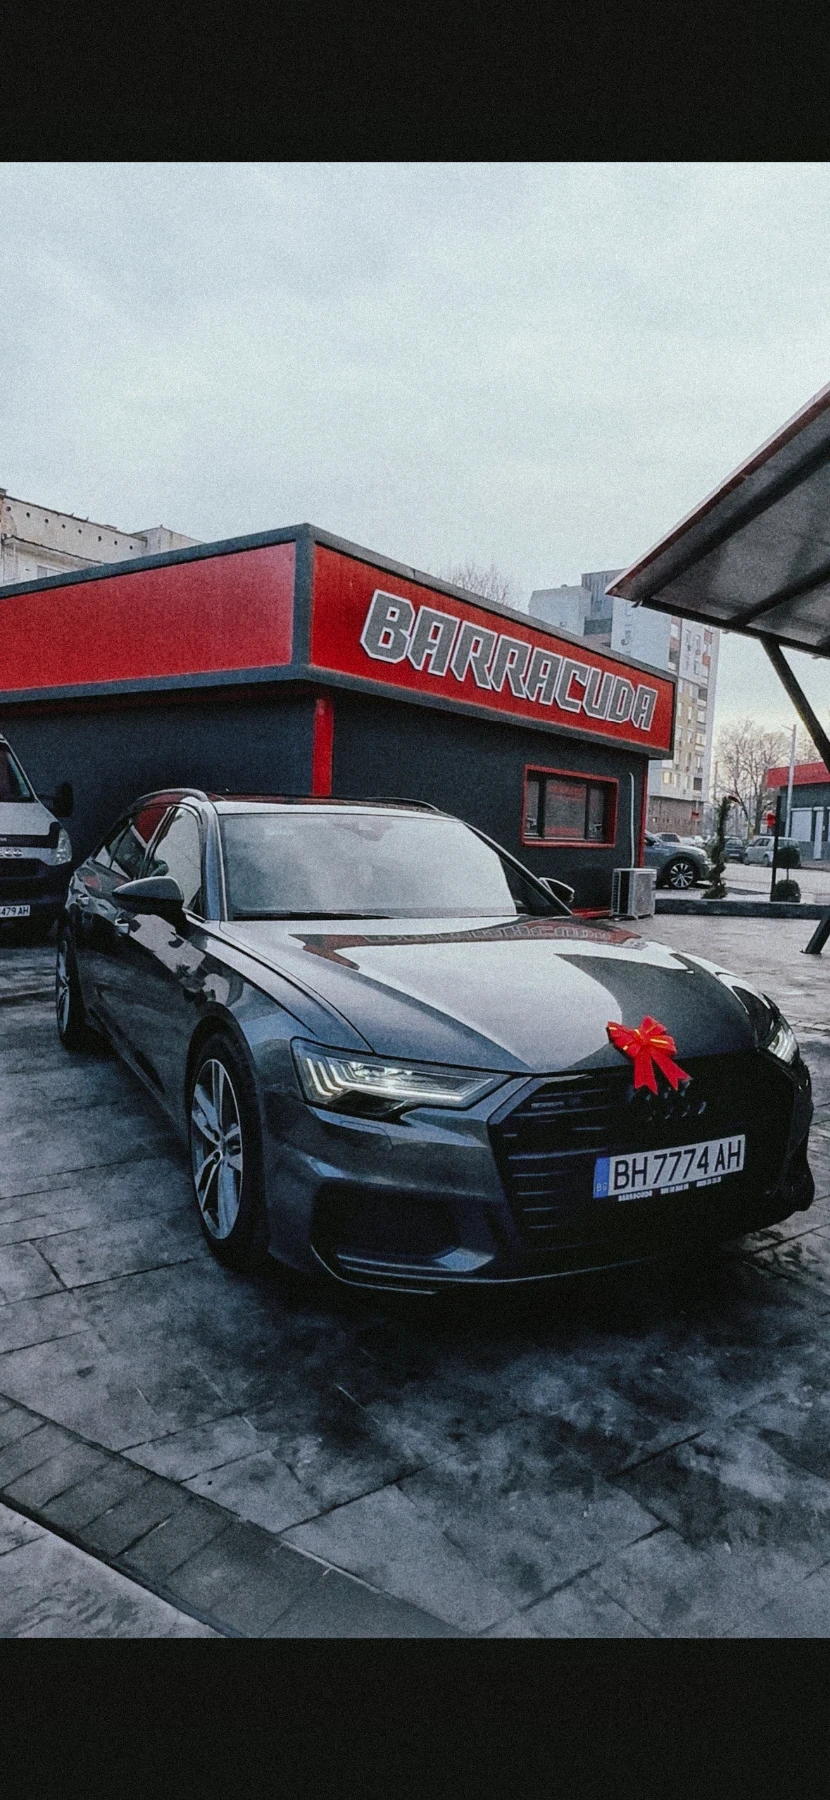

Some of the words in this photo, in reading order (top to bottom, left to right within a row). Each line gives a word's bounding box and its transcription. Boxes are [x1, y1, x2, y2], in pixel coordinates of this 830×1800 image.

[360, 588, 659, 732] BARRACUDA
[18, 905, 29, 915] AH
[613, 1156, 649, 1190] BH
[652, 1145, 709, 1185] 7774
[714, 1139, 742, 1173] AH
[596, 1182, 608, 1192] BG
